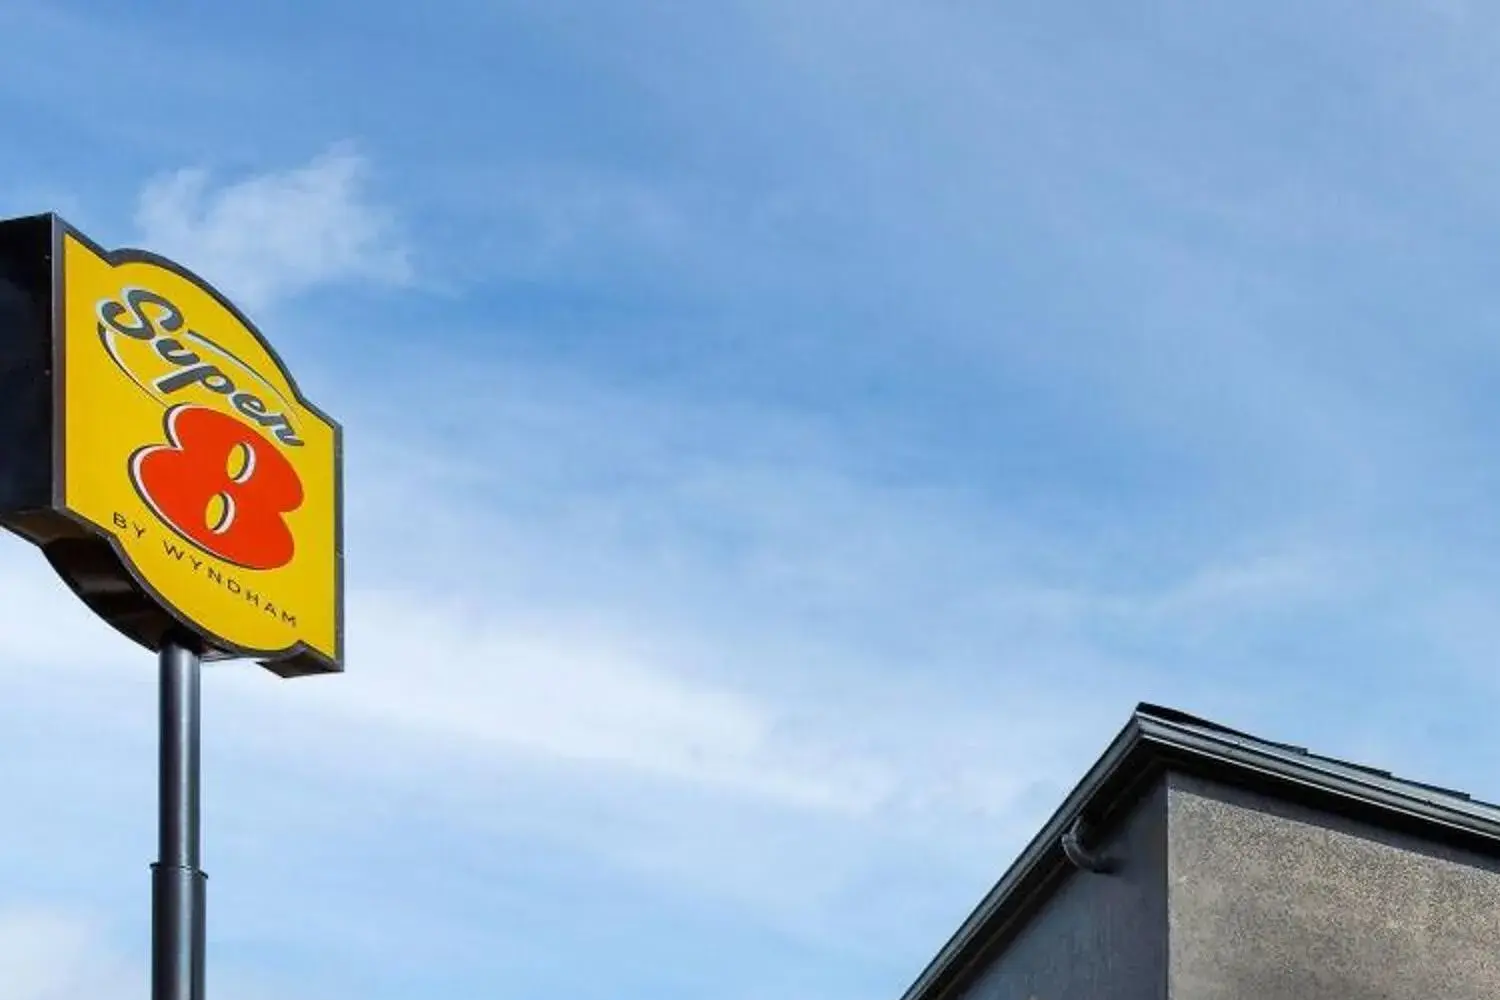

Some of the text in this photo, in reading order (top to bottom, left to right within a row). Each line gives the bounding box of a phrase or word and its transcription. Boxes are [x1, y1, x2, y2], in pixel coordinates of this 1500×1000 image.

[96, 286, 305, 446] Super
[127, 402, 305, 571] 8
[113, 511, 297, 628] BY WYNDHAM
